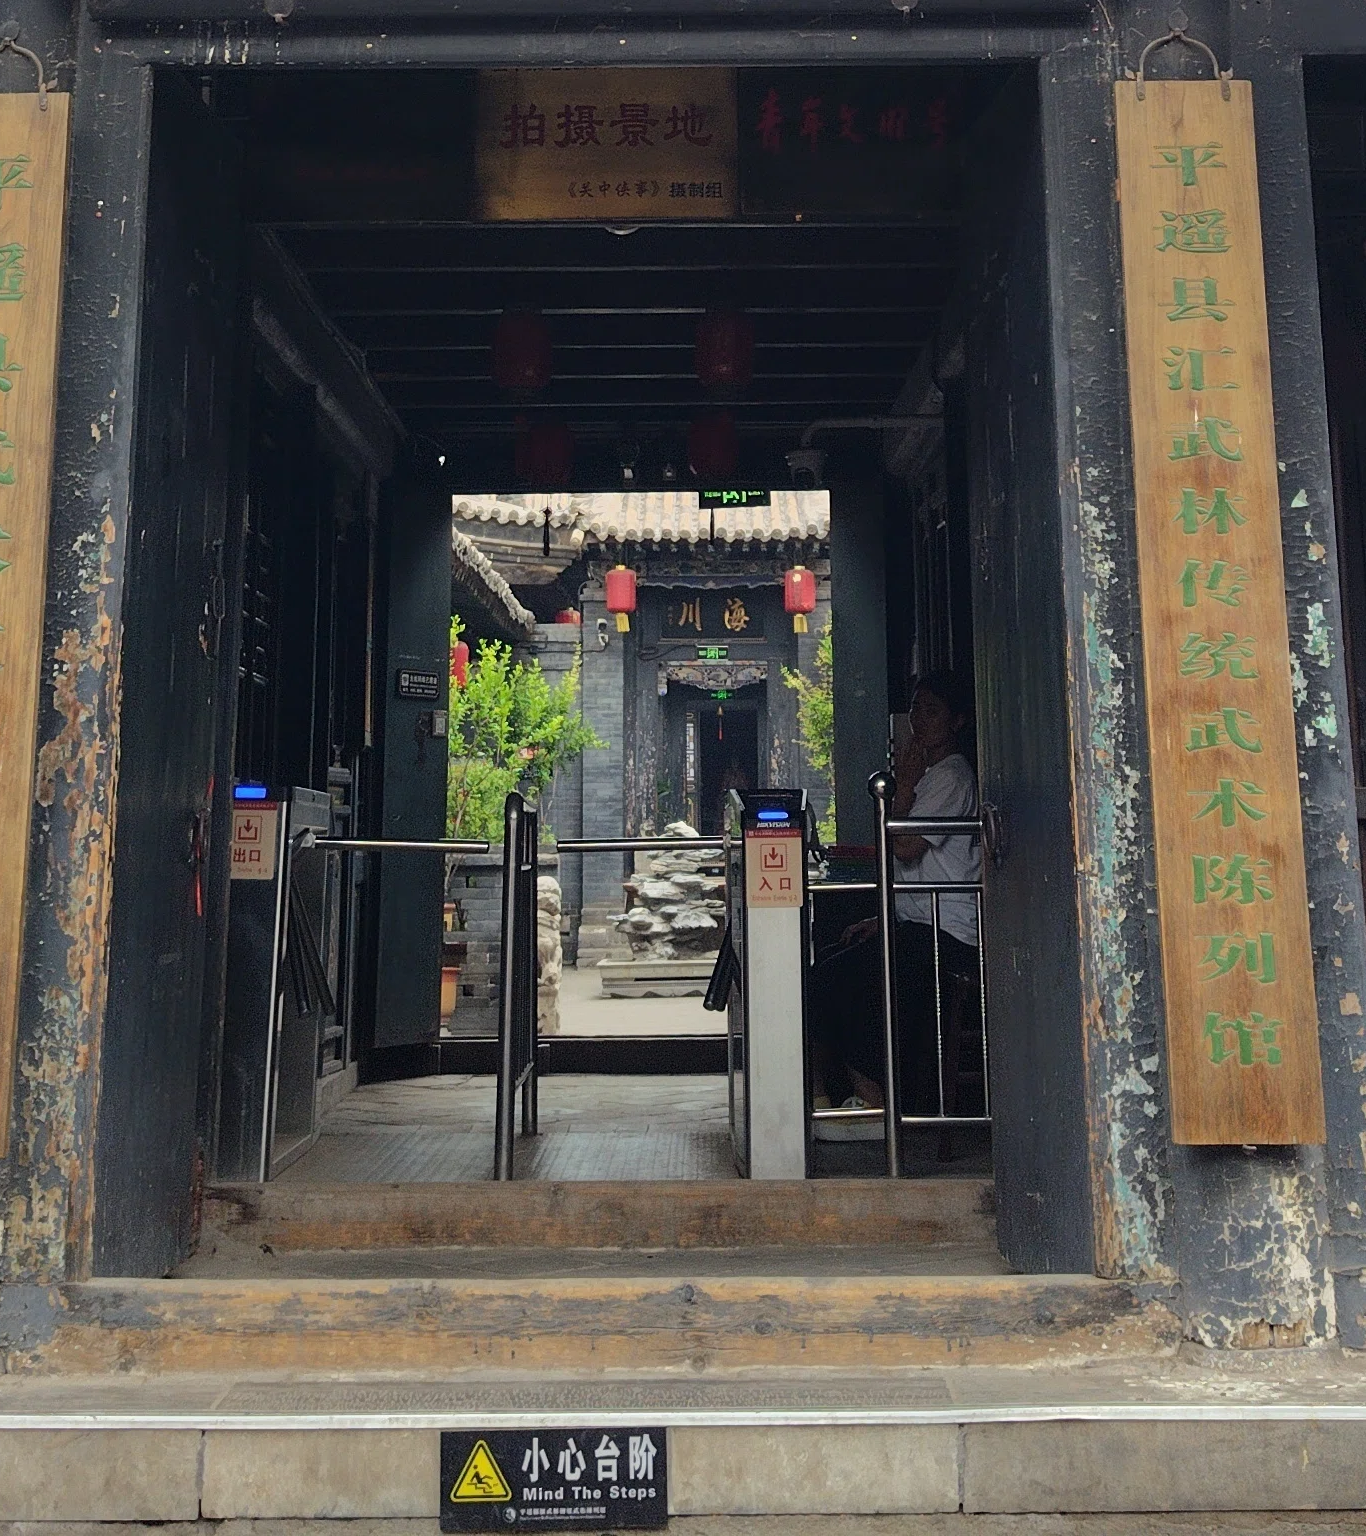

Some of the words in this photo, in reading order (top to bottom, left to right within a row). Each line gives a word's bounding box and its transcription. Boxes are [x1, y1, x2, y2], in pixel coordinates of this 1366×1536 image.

[499, 102, 714, 149] 拍摄景地
[1148, 141, 1284, 1069] 平遥县汇武林传统武术陈列馆
[232, 848, 261, 863] 出口
[759, 876, 792, 891] 入口
[521, 1433, 658, 1483] 小心台阶
[523, 1487, 564, 1501] Mind
[572, 1486, 602, 1500] The
[609, 1485, 657, 1501] Steps
